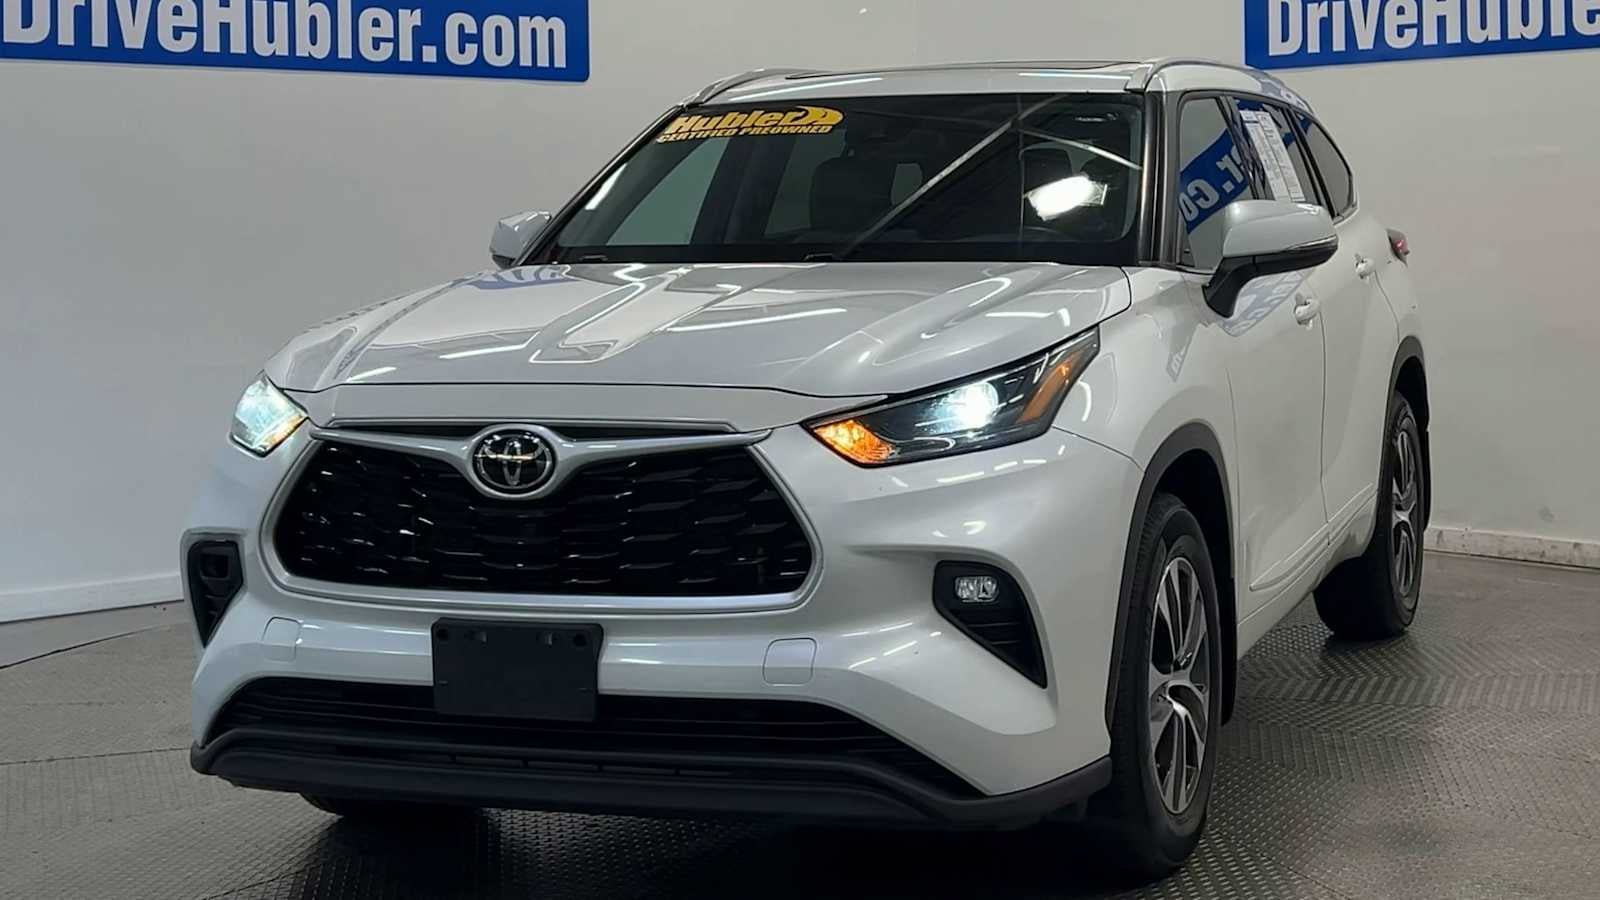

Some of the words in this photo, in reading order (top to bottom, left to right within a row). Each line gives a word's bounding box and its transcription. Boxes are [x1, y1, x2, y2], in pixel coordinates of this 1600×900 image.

[2, 0, 567, 69] DriveHubler.com
[656, 128, 739, 143] CERTIFIED
[739, 125, 833, 136] PREOWNED
[664, 109, 810, 134] Hubler
